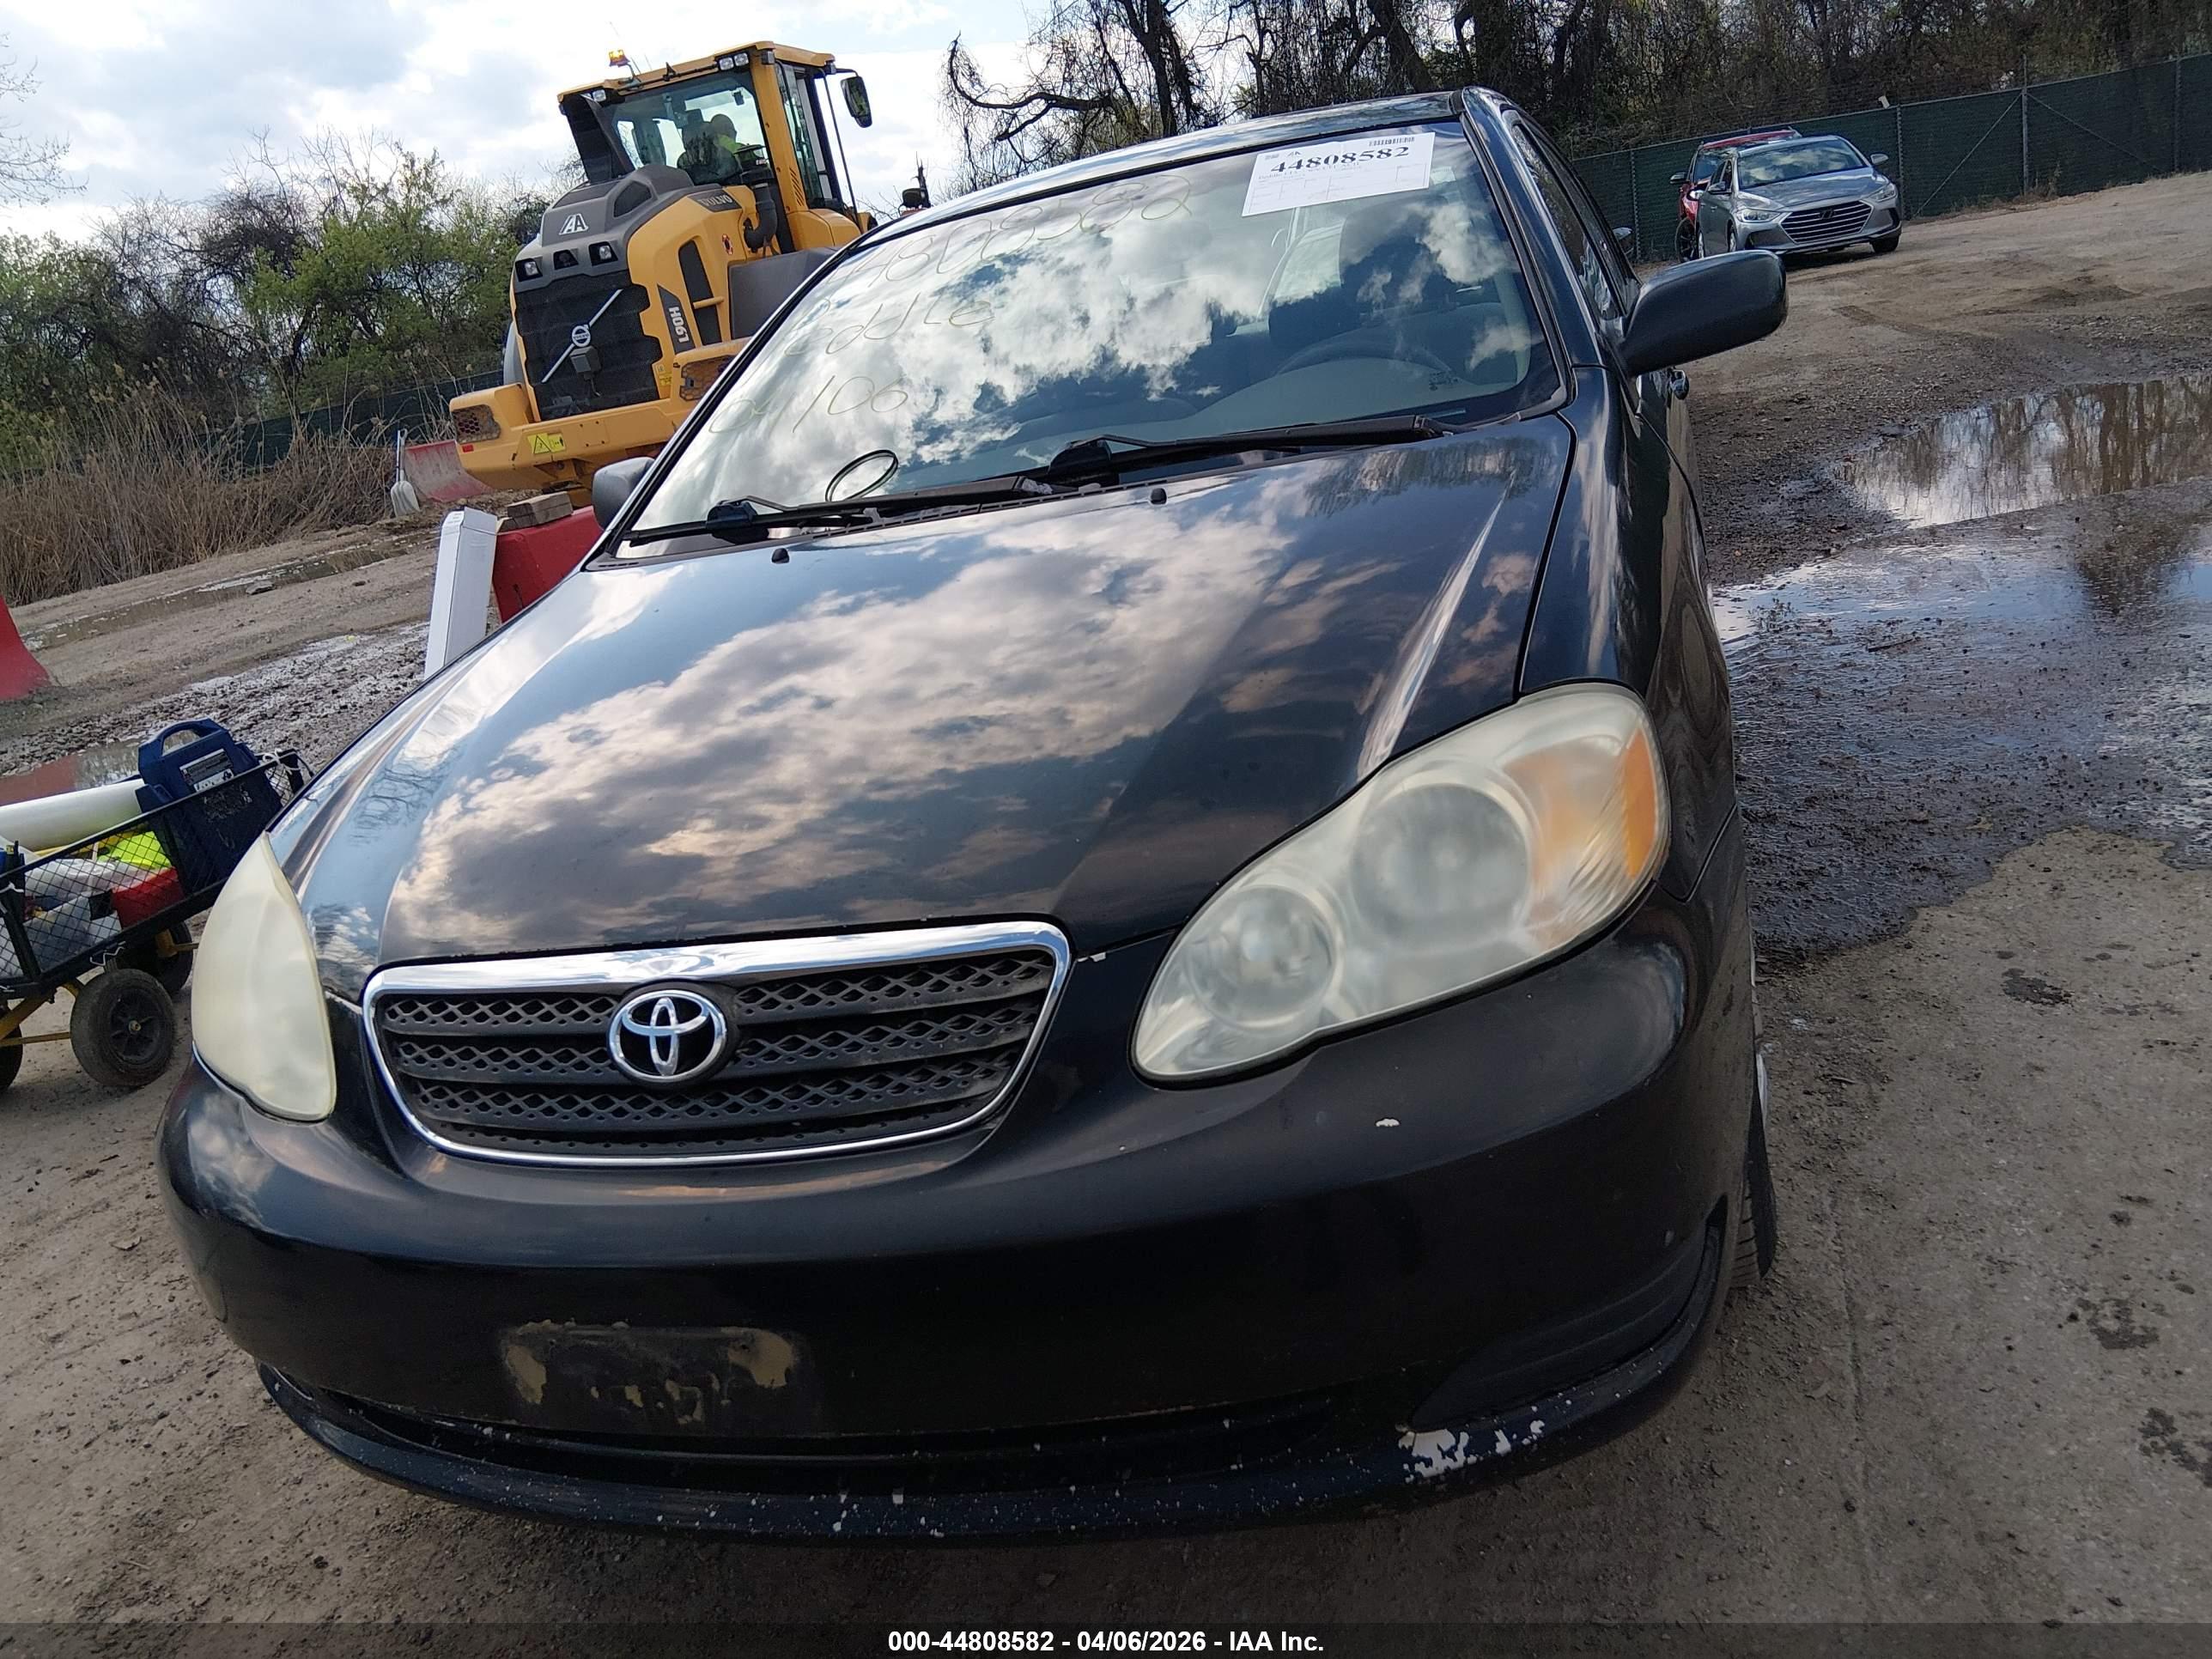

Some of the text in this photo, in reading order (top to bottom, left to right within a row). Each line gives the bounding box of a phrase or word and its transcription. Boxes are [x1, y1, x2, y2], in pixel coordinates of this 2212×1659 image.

[1271, 147, 1409, 173] 44808582
[697, 194, 733, 206] VOLVO
[668, 307, 690, 343] L90H
